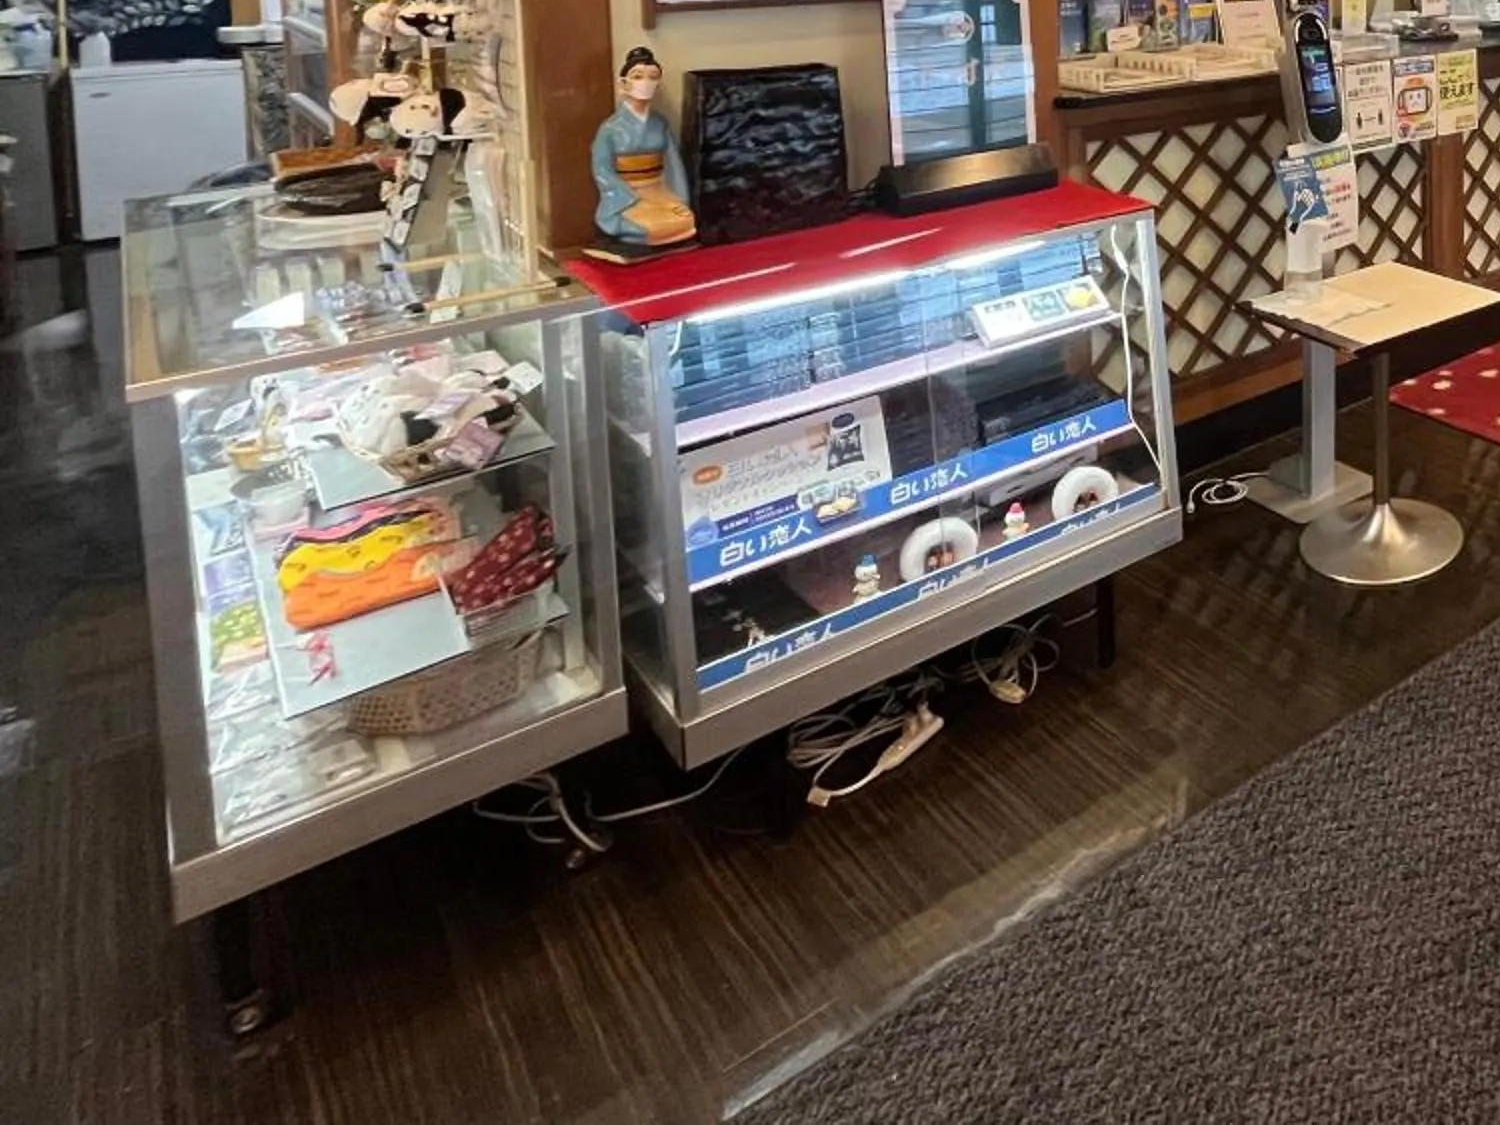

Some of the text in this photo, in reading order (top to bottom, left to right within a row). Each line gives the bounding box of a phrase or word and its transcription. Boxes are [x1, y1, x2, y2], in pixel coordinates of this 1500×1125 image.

[1031, 415, 1097, 453] 白い恋人
[890, 462, 969, 506] 白い恋人
[720, 517, 813, 568] 白い恋人
